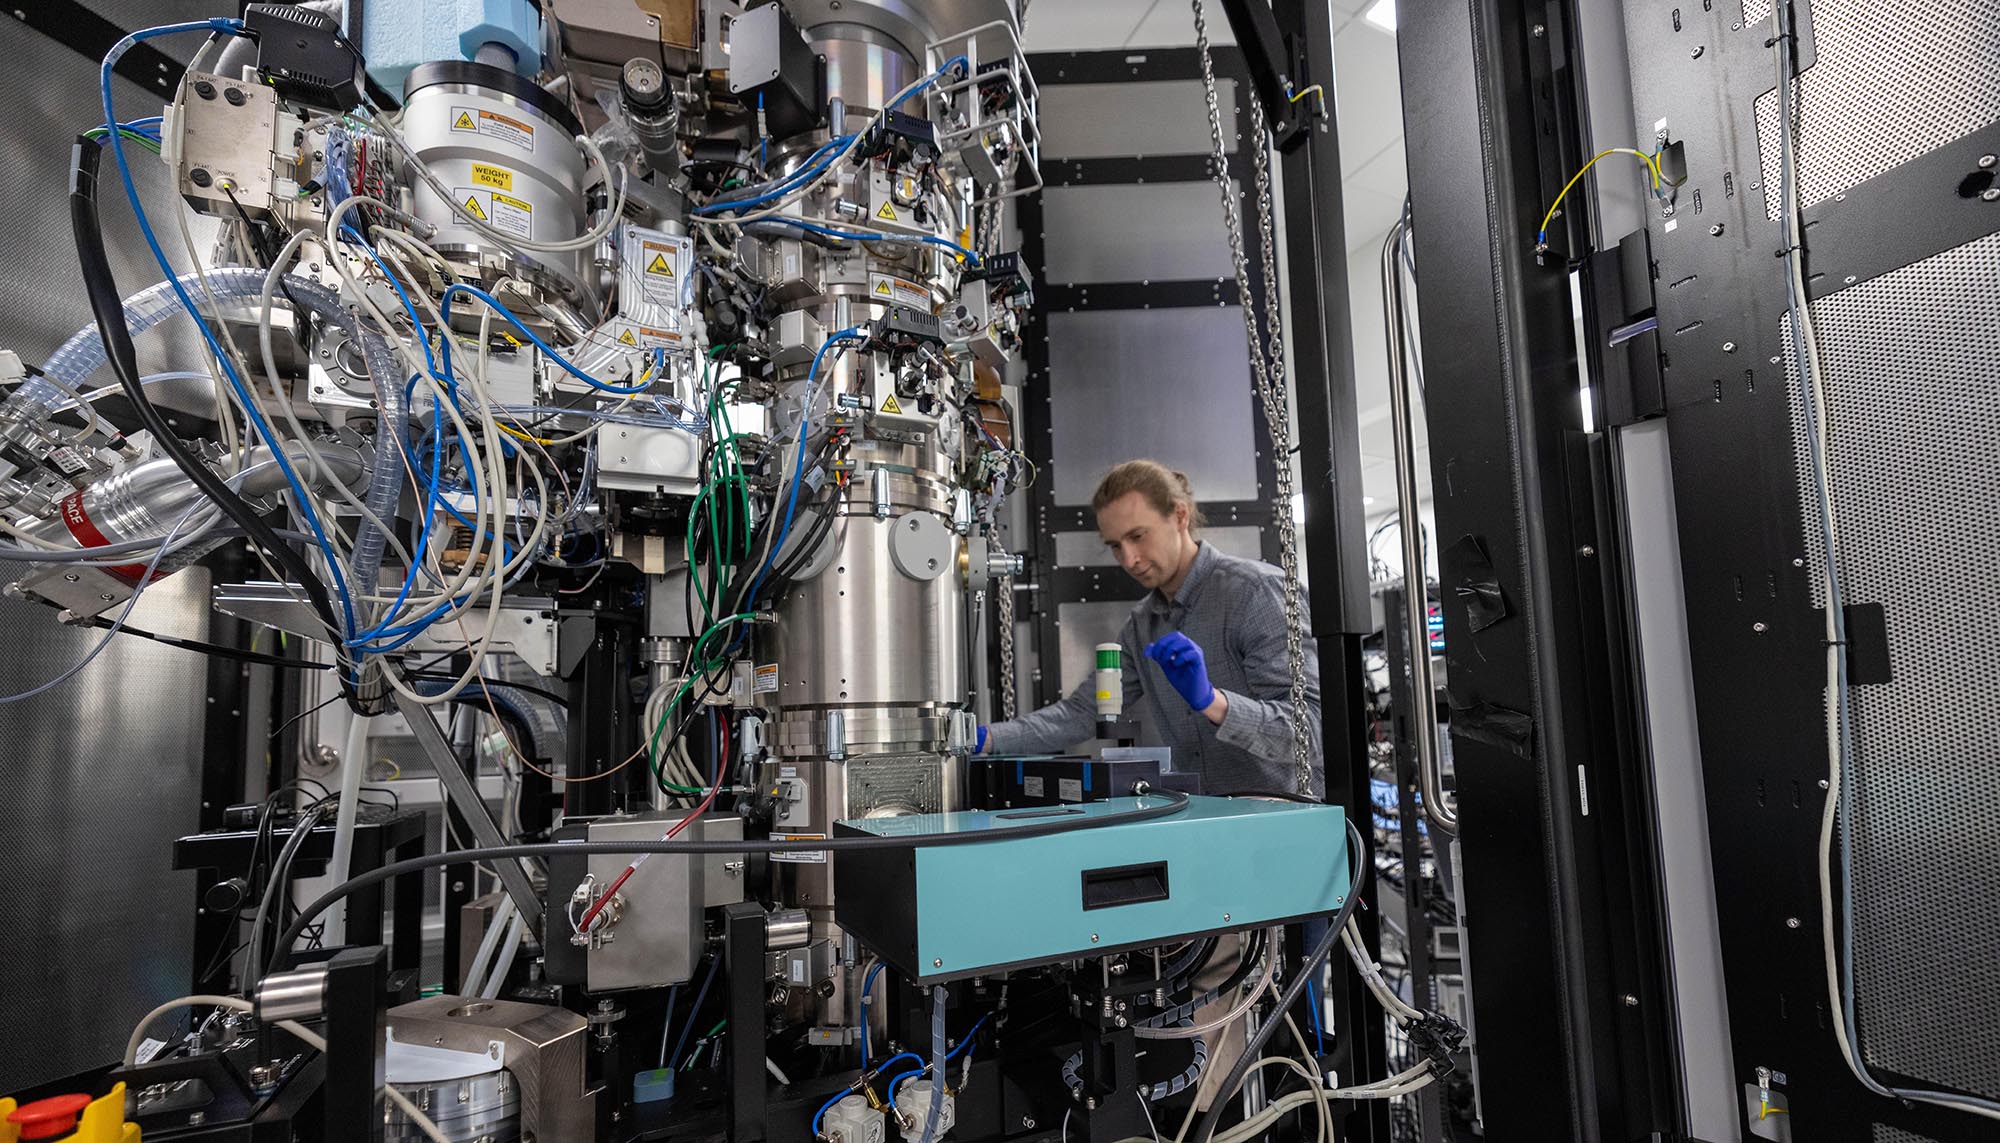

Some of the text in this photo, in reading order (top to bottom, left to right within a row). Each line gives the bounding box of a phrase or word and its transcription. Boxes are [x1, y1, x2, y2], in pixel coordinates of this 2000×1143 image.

[475, 166, 510, 180] WEIGHT
[480, 174, 504, 187] 50 kg
[67, 497, 84, 525] PACE
